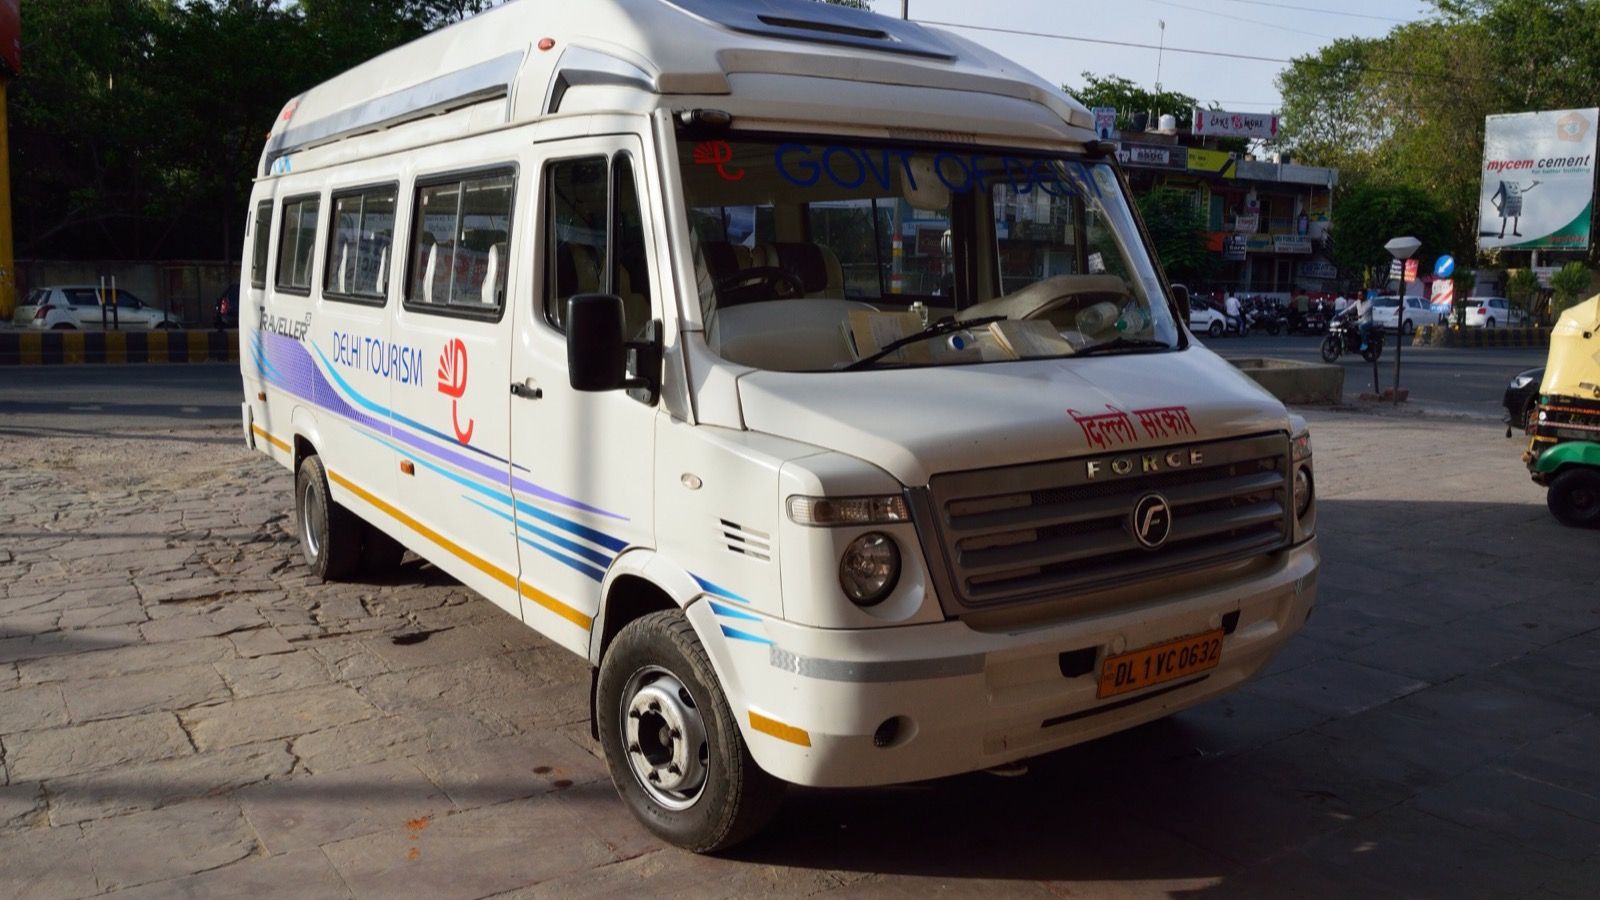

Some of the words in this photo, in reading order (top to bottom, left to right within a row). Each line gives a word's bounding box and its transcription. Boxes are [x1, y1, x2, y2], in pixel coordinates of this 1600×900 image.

[774, 143, 918, 191] GOVT
[933, 151, 992, 193] OF
[1486, 159, 1534, 174] mycem
[1537, 154, 1591, 169] cement
[259, 305, 308, 342] TRAVELLER
[333, 331, 362, 370] DELHI
[365, 337, 424, 388] TOURISM
[1067, 403, 1138, 450] दिल्ली
[1131, 406, 1197, 440] सरकार
[1086, 449, 1204, 481] FORCE
